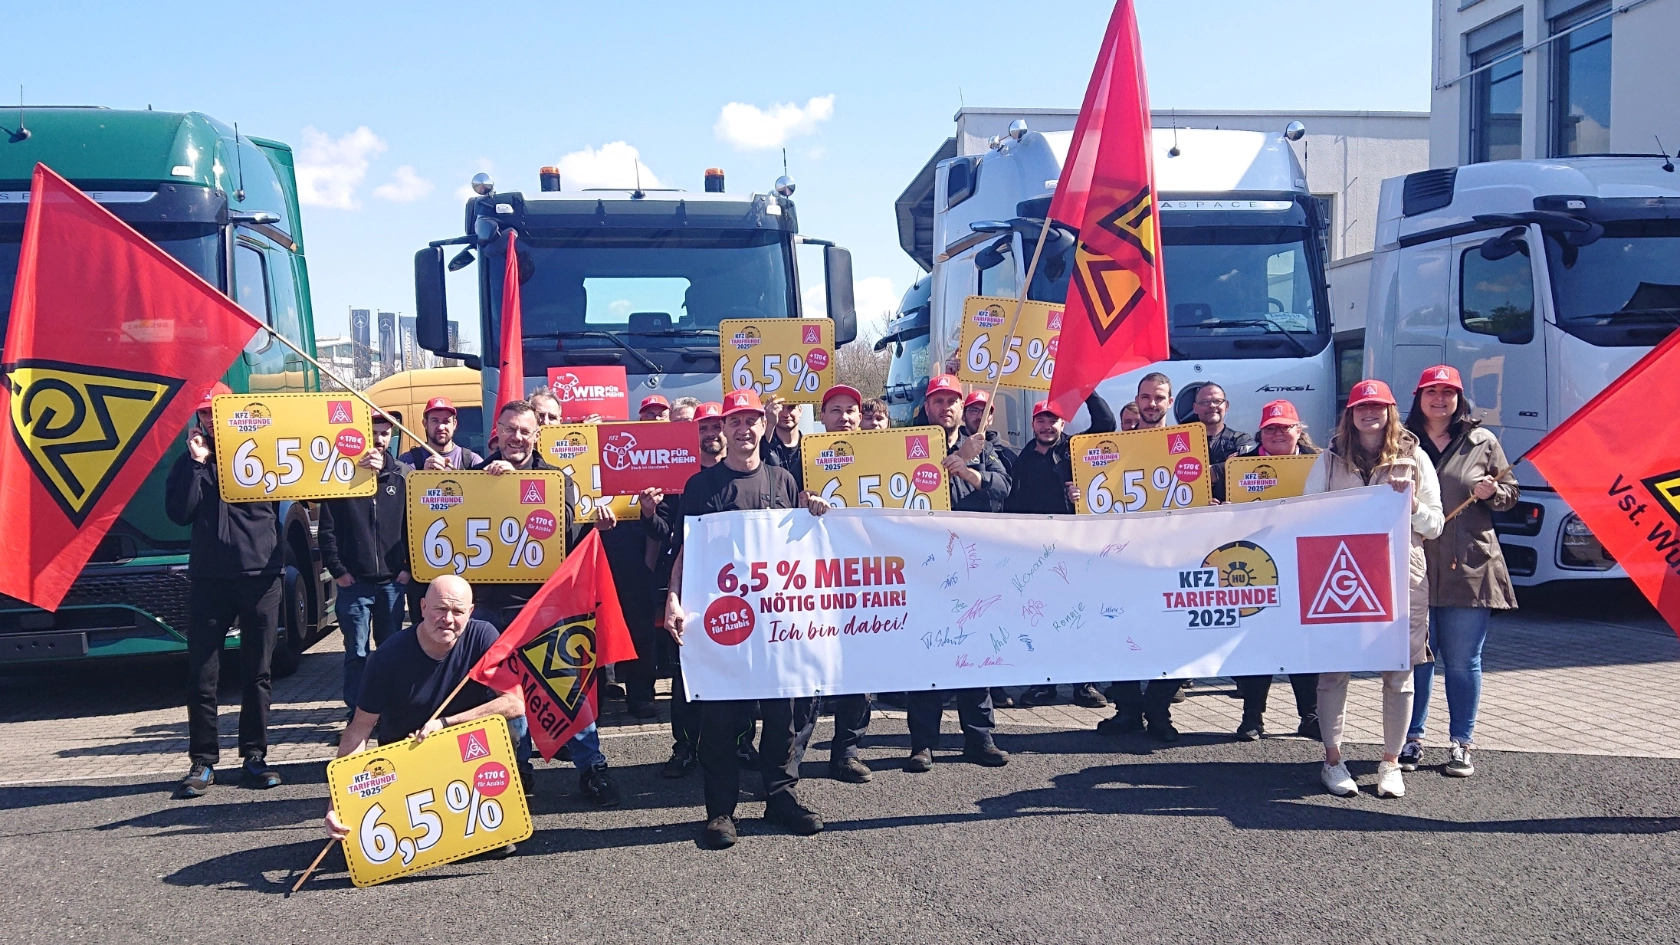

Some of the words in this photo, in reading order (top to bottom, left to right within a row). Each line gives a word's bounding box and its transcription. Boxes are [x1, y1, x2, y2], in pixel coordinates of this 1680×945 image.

[967, 333, 1023, 380] 6,5
[1027, 338, 1056, 380] %
[732, 354, 783, 397] 6,5
[787, 353, 821, 394] %
[572, 386, 605, 398] WIR
[233, 437, 305, 494] 6,5
[310, 435, 356, 484] %
[628, 449, 671, 465] WIR
[671, 448, 688, 456] FÜR
[671, 456, 696, 464] MEHR
[816, 456, 854, 465] TARIFRUNDE
[421, 496, 462, 504] TARIFRUNDE
[427, 489, 441, 497] KFZ
[889, 471, 932, 509] %
[1087, 469, 1148, 514] 6,5
[1152, 466, 1194, 509] %
[1607, 473, 1648, 527] Vst.
[423, 516, 494, 575] 6,5
[499, 516, 545, 569] %
[717, 562, 769, 598] 6,5
[776, 560, 807, 591] %
[814, 556, 906, 589] MEHR
[1179, 570, 1215, 589] KFZ
[1231, 573, 1246, 583] HU
[760, 592, 815, 614] NÖTIG
[820, 592, 858, 610] UND
[862, 590, 907, 608] FAIR!
[1162, 588, 1278, 609] TARIFRUNDE
[710, 617, 718, 626] +
[718, 611, 738, 625] 170
[739, 608, 749, 619] €
[1188, 608, 1237, 628] 2025
[711, 626, 723, 635] für
[725, 620, 750, 632] Azubis
[768, 620, 803, 643] Ich
[808, 620, 840, 641] bin
[843, 612, 908, 636] dabei!
[521, 672, 570, 740] Metall
[348, 774, 396, 793] TARIFRUNDE
[354, 772, 370, 783] KFZ
[360, 786, 381, 798] 2025
[359, 787, 444, 867] 6,5
[445, 779, 504, 839] %
